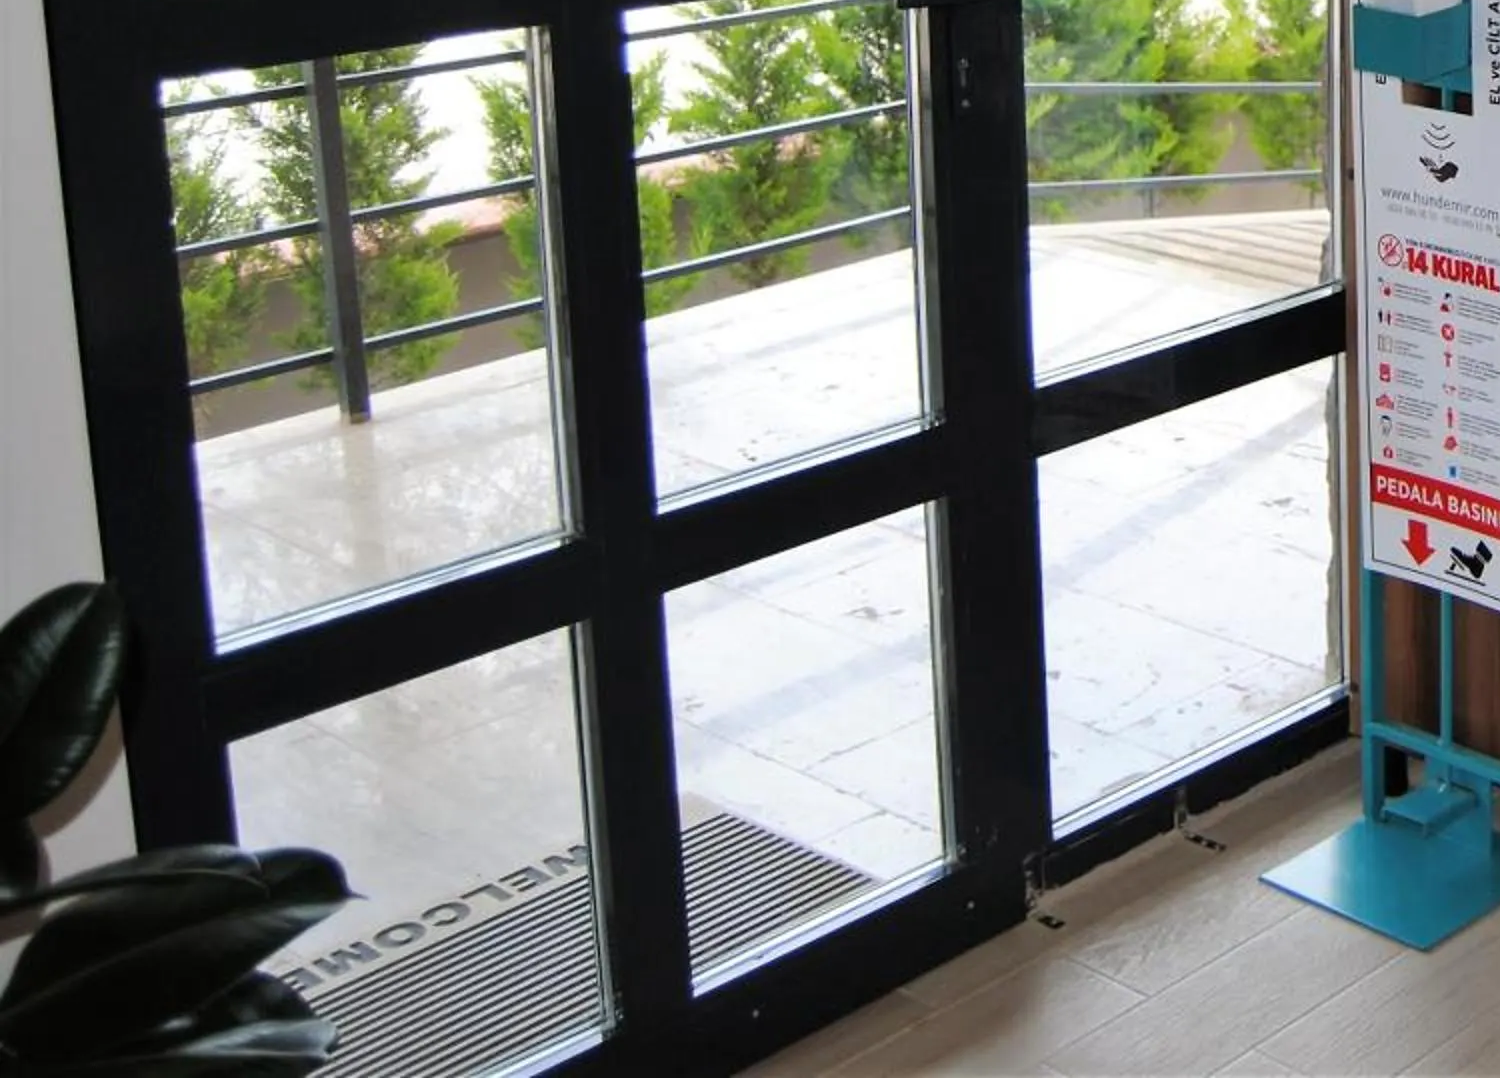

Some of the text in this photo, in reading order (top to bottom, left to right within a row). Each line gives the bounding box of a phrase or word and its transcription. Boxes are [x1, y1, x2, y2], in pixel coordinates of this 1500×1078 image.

[1489, 84, 1500, 106] EL
[1380, 187, 1500, 222] www.hundemir.com
[1406, 247, 1429, 275] 14
[1376, 475, 1443, 510] PEDALA
